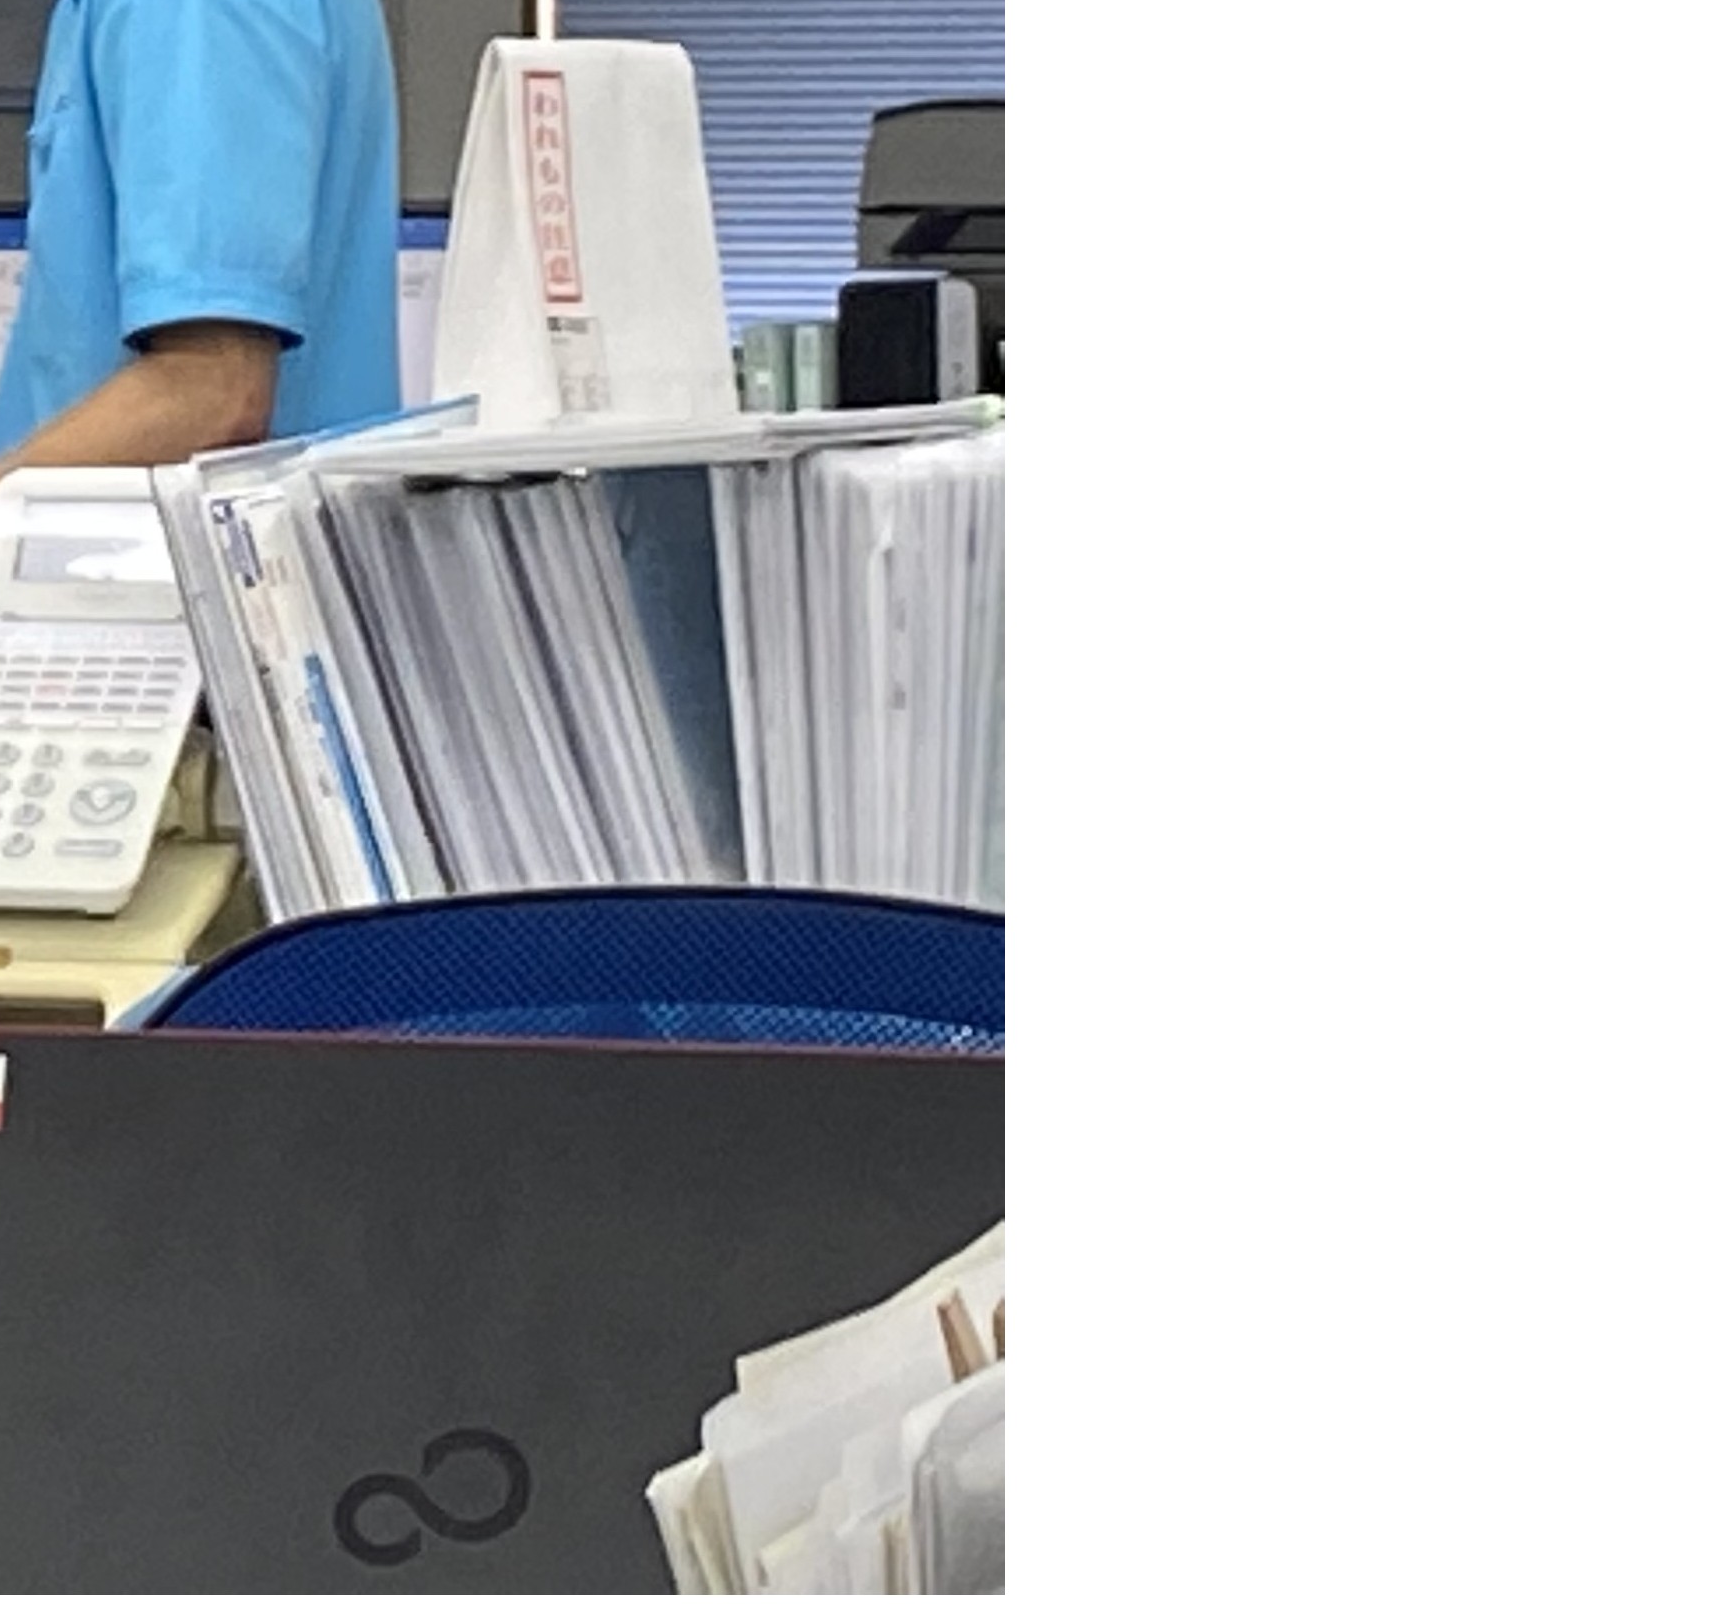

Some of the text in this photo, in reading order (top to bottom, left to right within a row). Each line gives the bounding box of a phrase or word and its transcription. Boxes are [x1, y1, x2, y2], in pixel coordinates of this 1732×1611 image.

[533, 91, 573, 284] われもの注意
